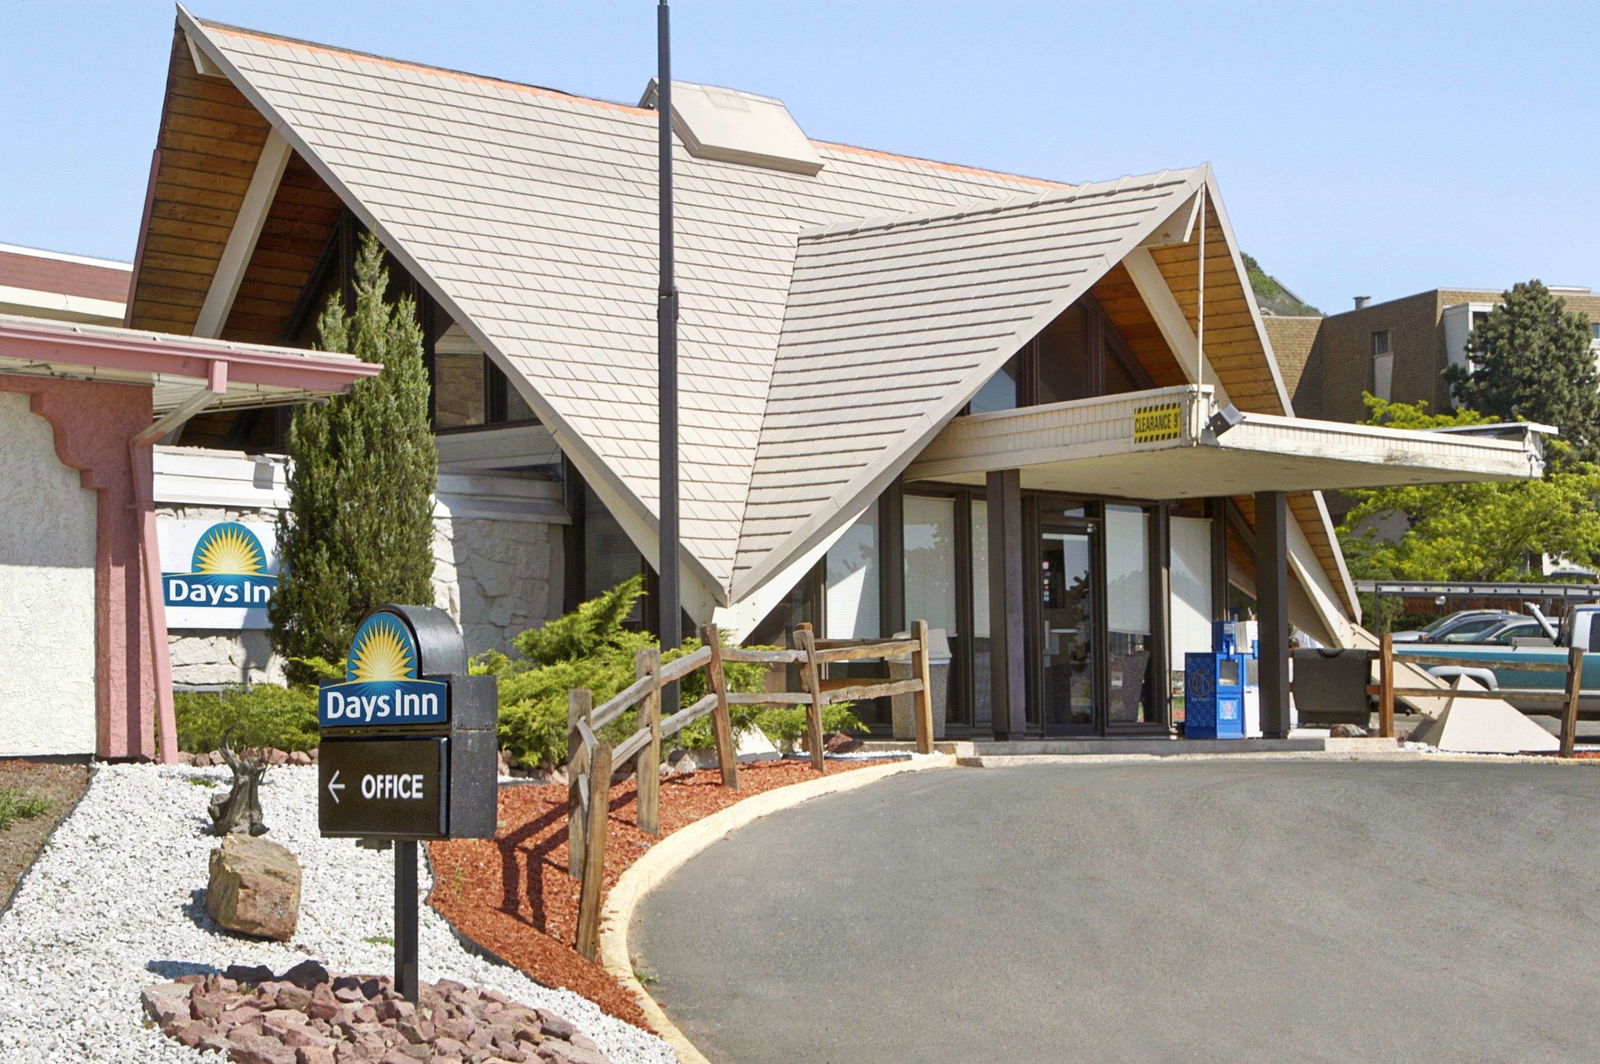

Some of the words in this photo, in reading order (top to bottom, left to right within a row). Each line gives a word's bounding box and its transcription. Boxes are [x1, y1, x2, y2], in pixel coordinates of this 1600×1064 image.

[1135, 413, 1171, 433] CLEARANCE
[169, 579, 239, 606] Days
[243, 581, 277, 603] In
[327, 691, 390, 722] Days
[395, 689, 438, 716] Inn
[361, 773, 424, 799] OFFICE
